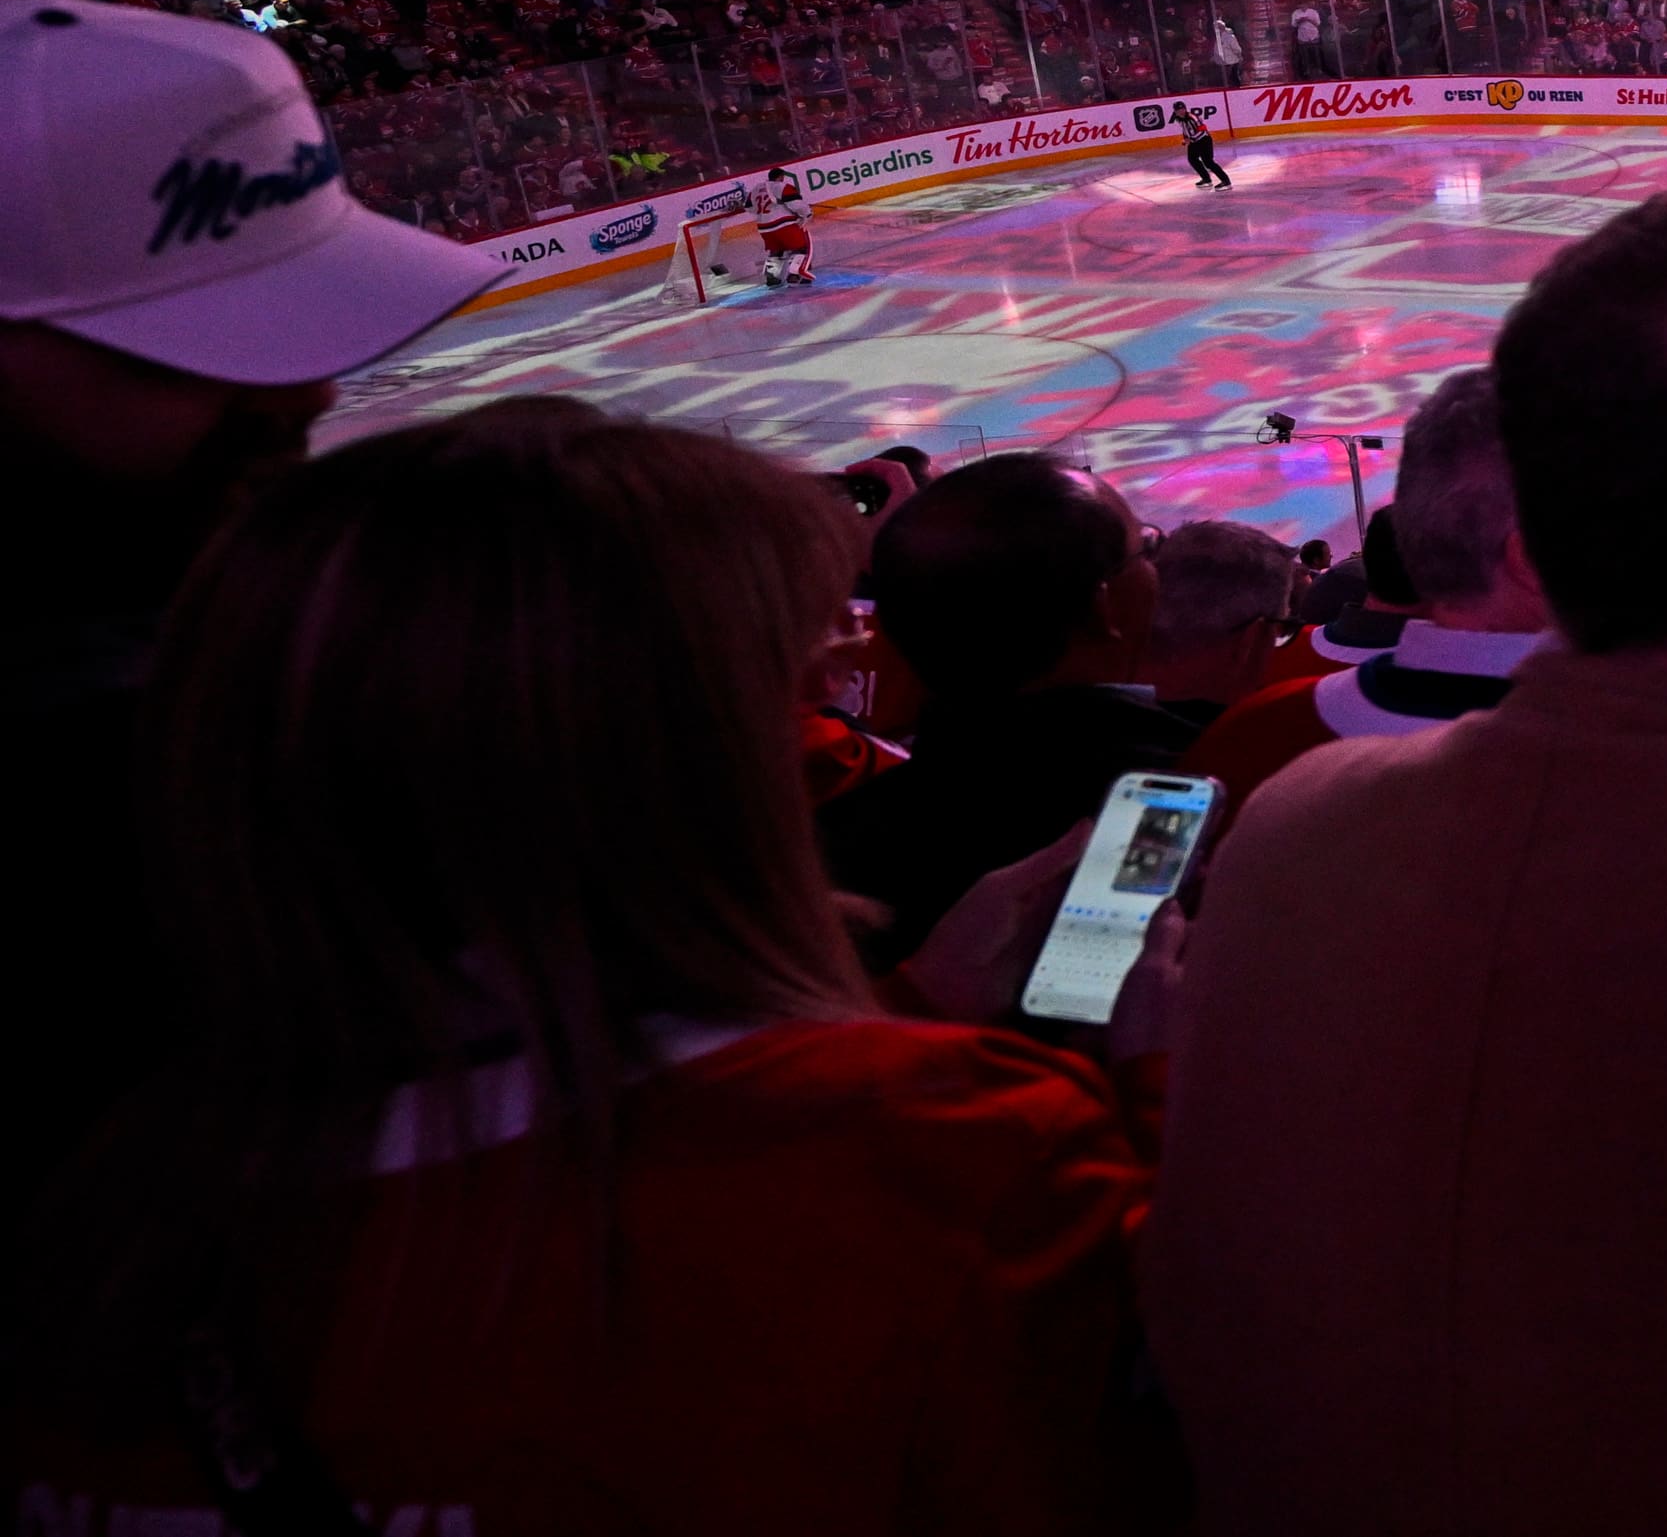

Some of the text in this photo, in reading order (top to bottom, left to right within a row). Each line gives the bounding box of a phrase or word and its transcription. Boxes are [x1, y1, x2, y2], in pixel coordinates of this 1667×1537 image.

[1254, 84, 1413, 122] Molson
[1445, 80, 1584, 110] C'EST KD OU RIEN
[945, 119, 1123, 164] Tim Hortons
[807, 150, 934, 192] Desjardins
[755, 193, 772, 215] 32
[597, 212, 653, 243] Sponge
